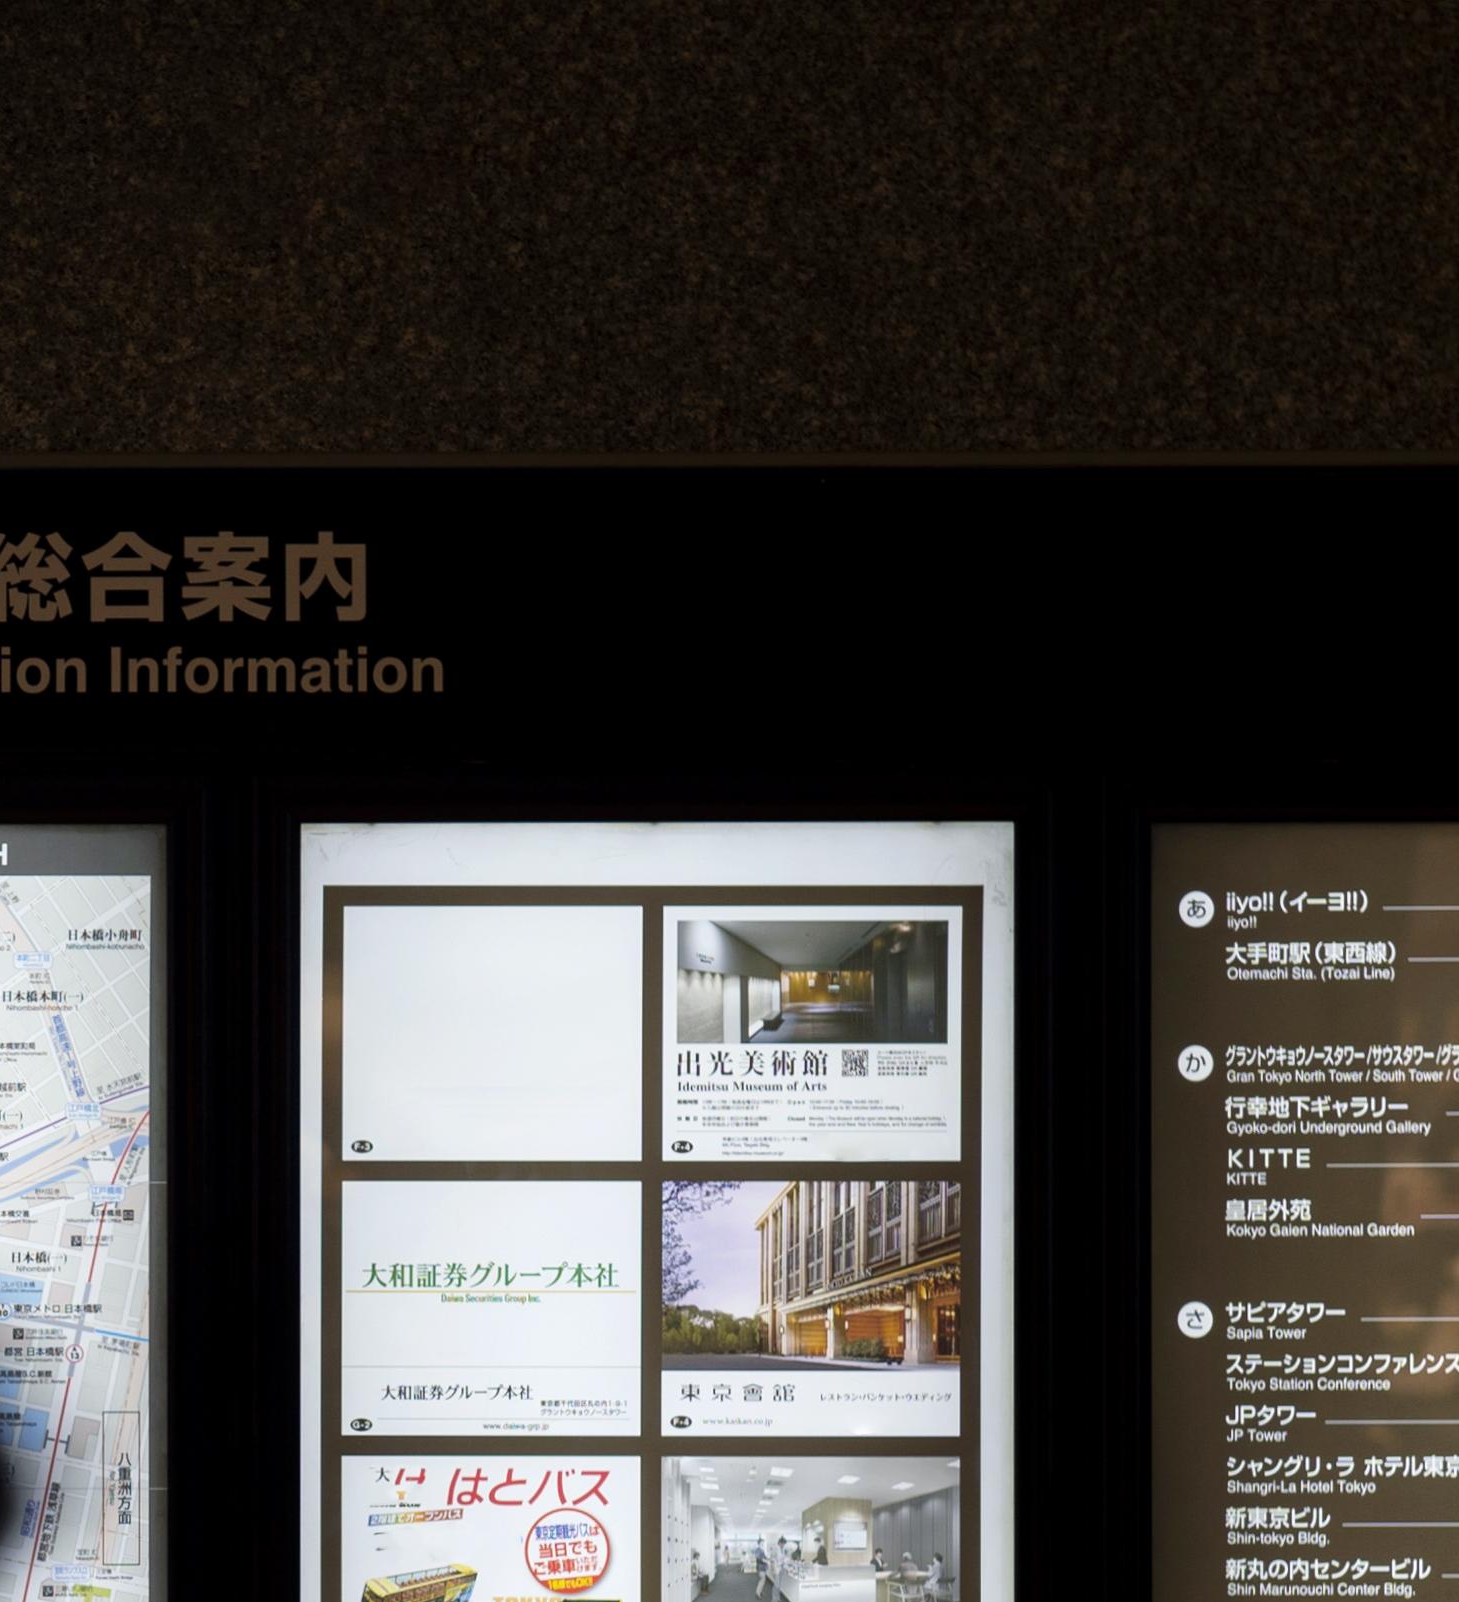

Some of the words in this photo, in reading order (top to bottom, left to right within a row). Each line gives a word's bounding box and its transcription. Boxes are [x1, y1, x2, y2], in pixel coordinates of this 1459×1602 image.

[110, 645, 444, 694] Information
[1186, 899, 1208, 921] あ
[1227, 916, 1258, 931] iiyo!!
[1226, 967, 1290, 982] Otemachi
[1291, 967, 1317, 981] Sta.
[1320, 967, 1362, 983] (Tozai
[1363, 967, 1396, 983] Line)
[676, 1049, 828, 1077] 出光美術館
[677, 1081, 729, 1092] Idemitsu
[732, 1081, 784, 1092] Museum
[786, 1081, 798, 1092] of
[803, 1081, 828, 1092] Arts
[1227, 1147, 1311, 1169] KITTE
[361, 1262, 620, 1290] 大和証券グループ本社
[382, 1384, 530, 1401] 大和証券グループ本社
[680, 1383, 795, 1402] 東京會舘
[446, 1467, 610, 1510] はとバス
